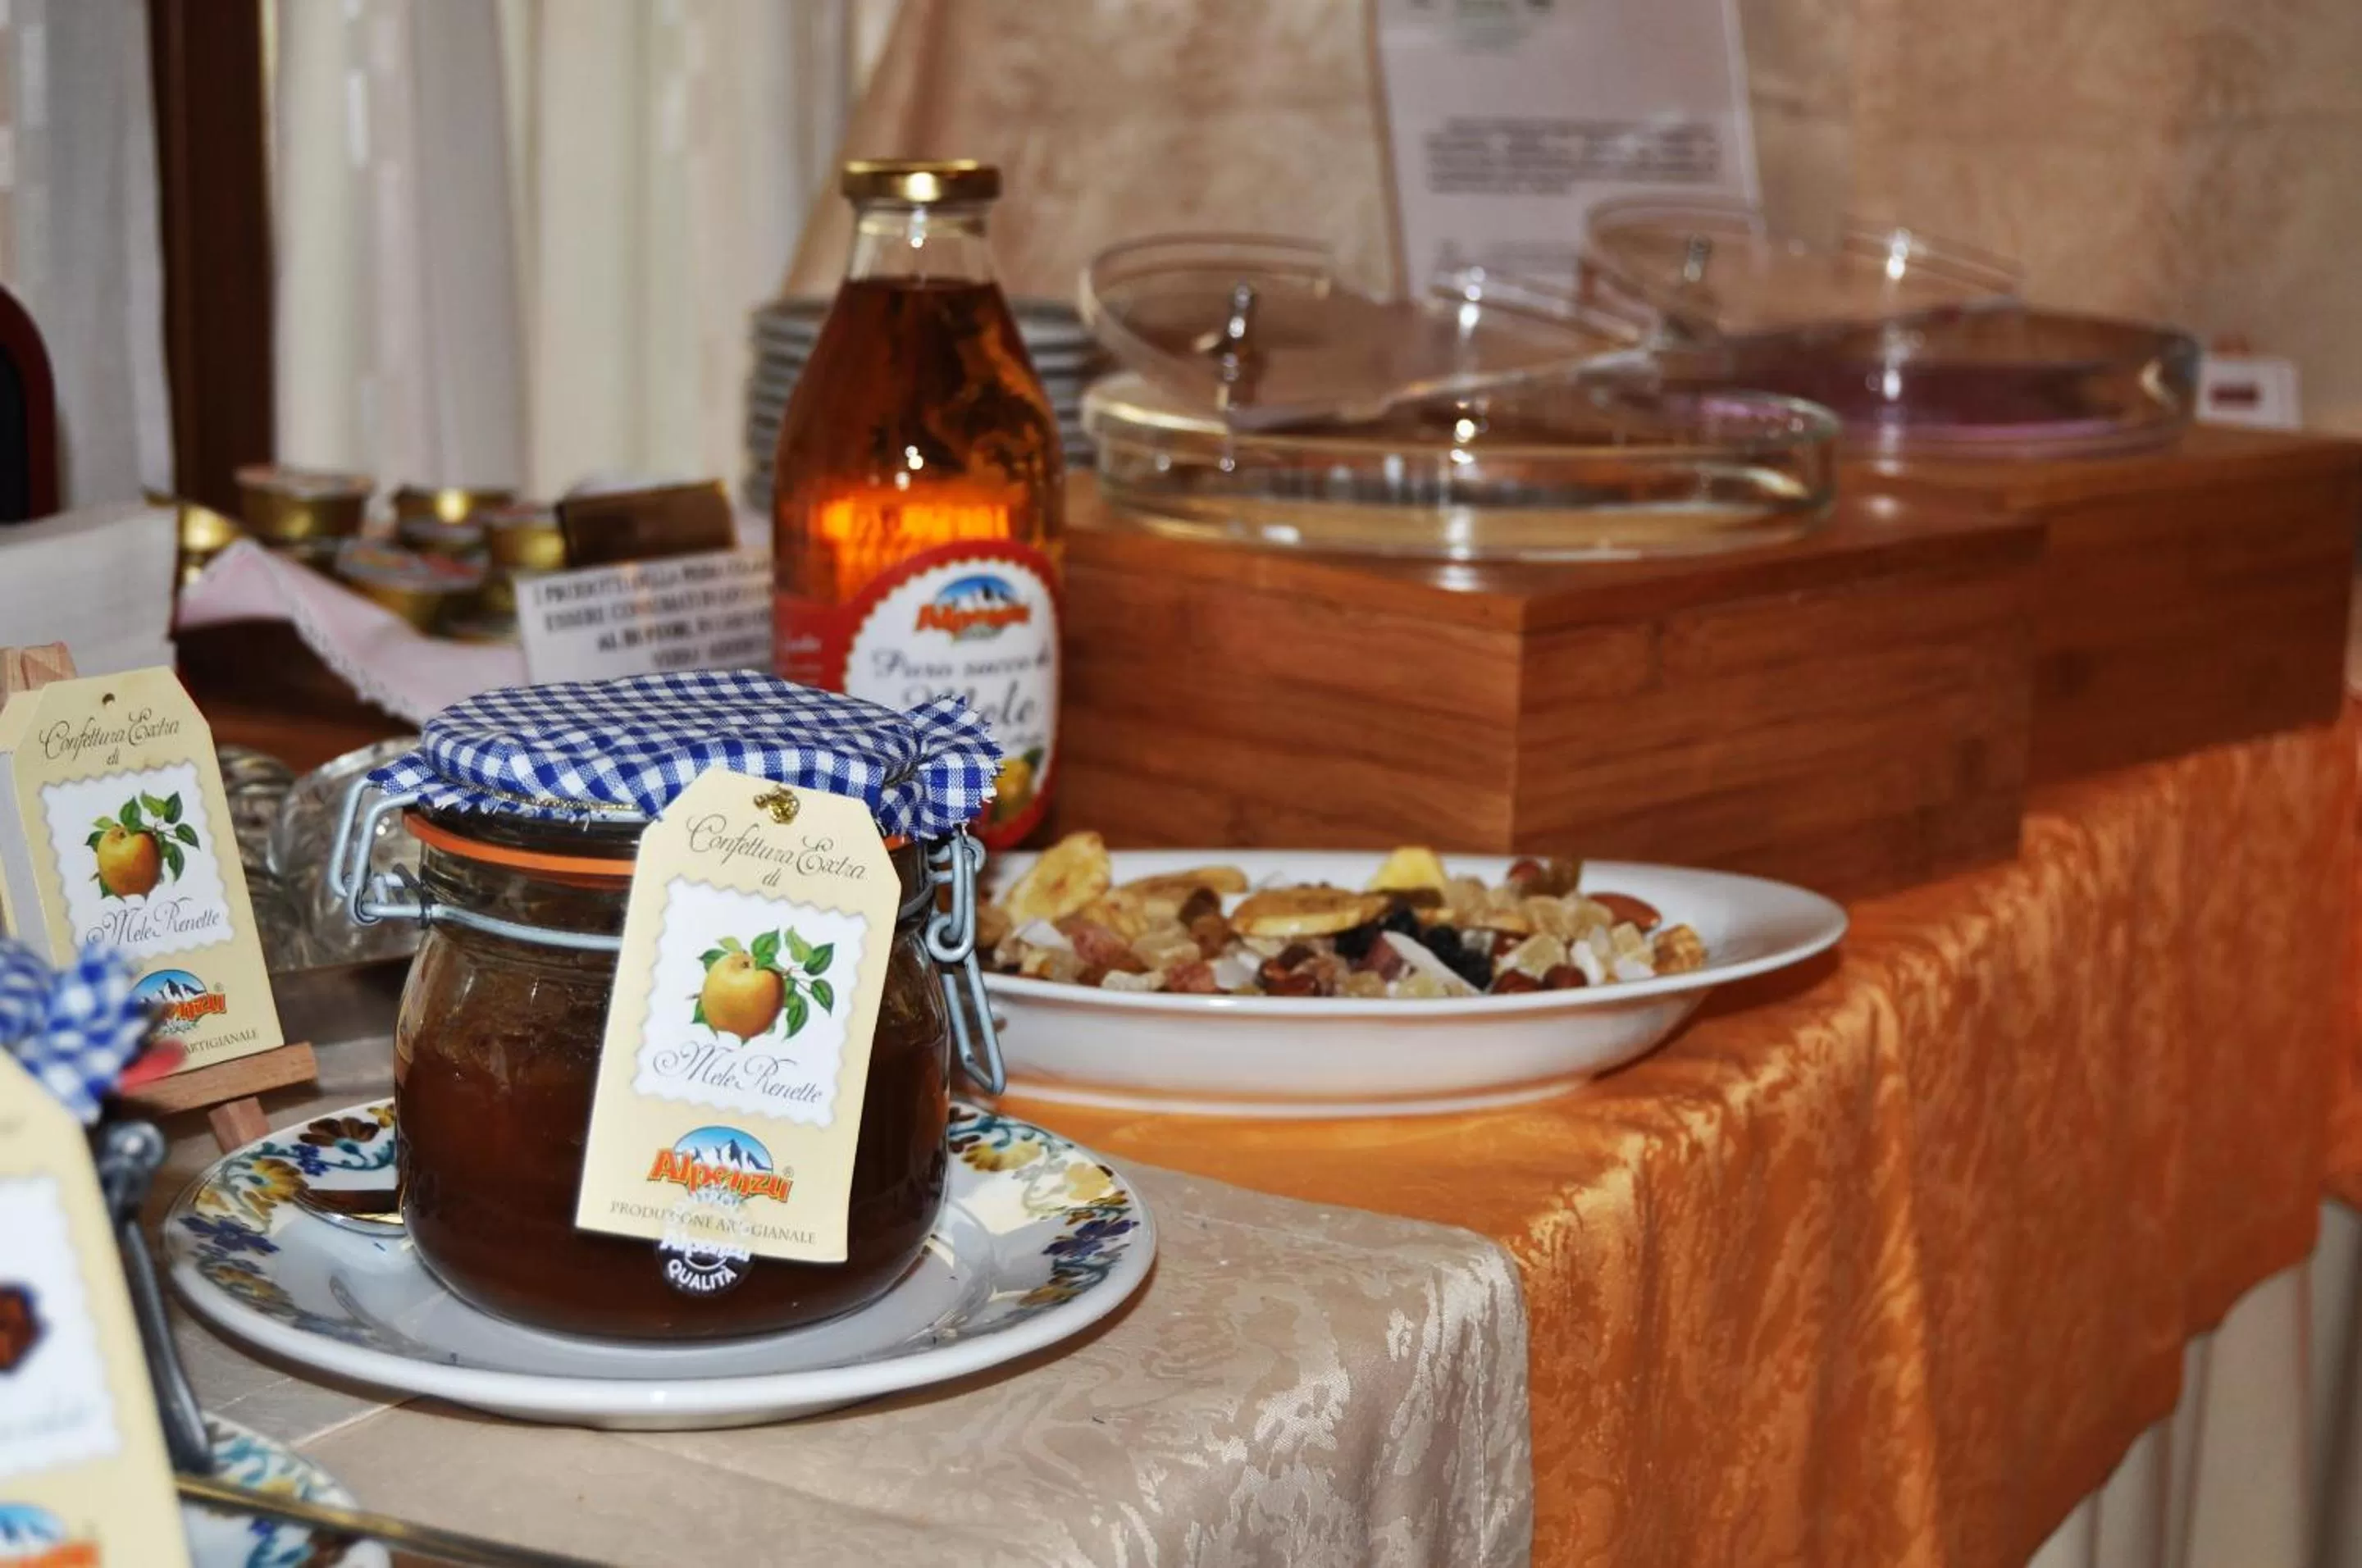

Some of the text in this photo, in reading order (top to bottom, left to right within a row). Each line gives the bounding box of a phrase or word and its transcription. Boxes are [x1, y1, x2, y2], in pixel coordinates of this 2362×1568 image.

[39, 707, 180, 761] Confettura Extra
[106, 748, 120, 765] di
[686, 814, 867, 881] Confettura Extra
[762, 868, 782, 888] di
[86, 896, 220, 945] Mele Renette
[653, 1040, 823, 1104] Mele Renette
[646, 1148, 795, 1204] Alpenzu
[715, 1218, 816, 1245] ARGIANALE
